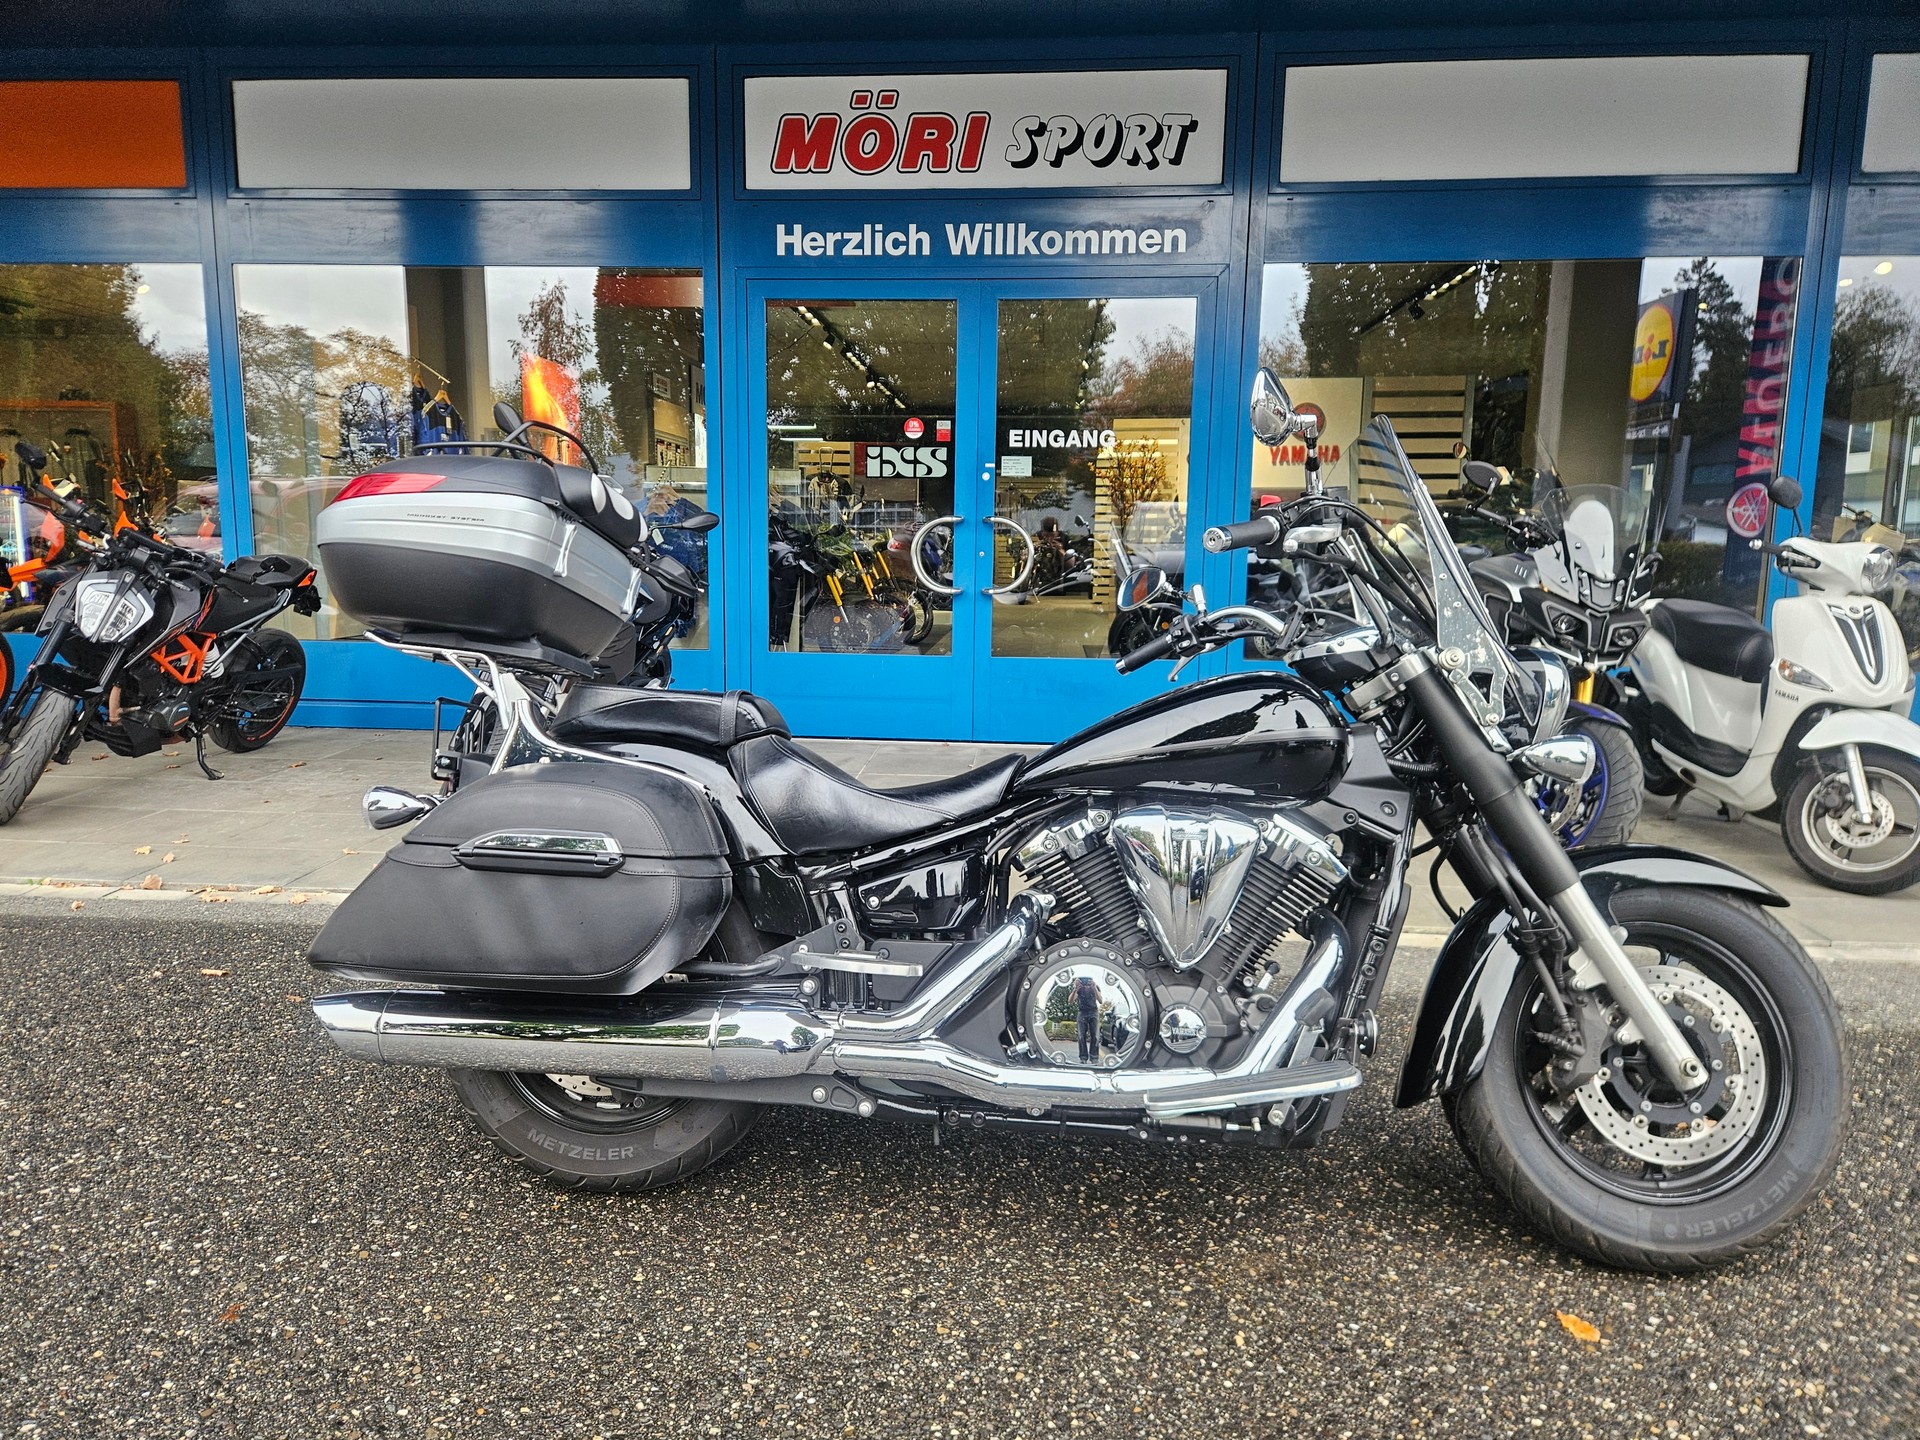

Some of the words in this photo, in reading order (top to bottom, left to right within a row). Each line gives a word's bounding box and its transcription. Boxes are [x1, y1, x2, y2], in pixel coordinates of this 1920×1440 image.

[771, 89, 991, 175] MÖRI
[1005, 113, 1199, 170] SPORT
[776, 223, 930, 256] Herzlich
[945, 222, 1187, 255] Willkommen
[1008, 429, 1115, 448] EINGANG
[1269, 444, 1340, 465] YAMHA
[1775, 689, 1799, 702] YAMAHA
[526, 1127, 634, 1160] METZELER
[1684, 1169, 1799, 1238] METZELER
